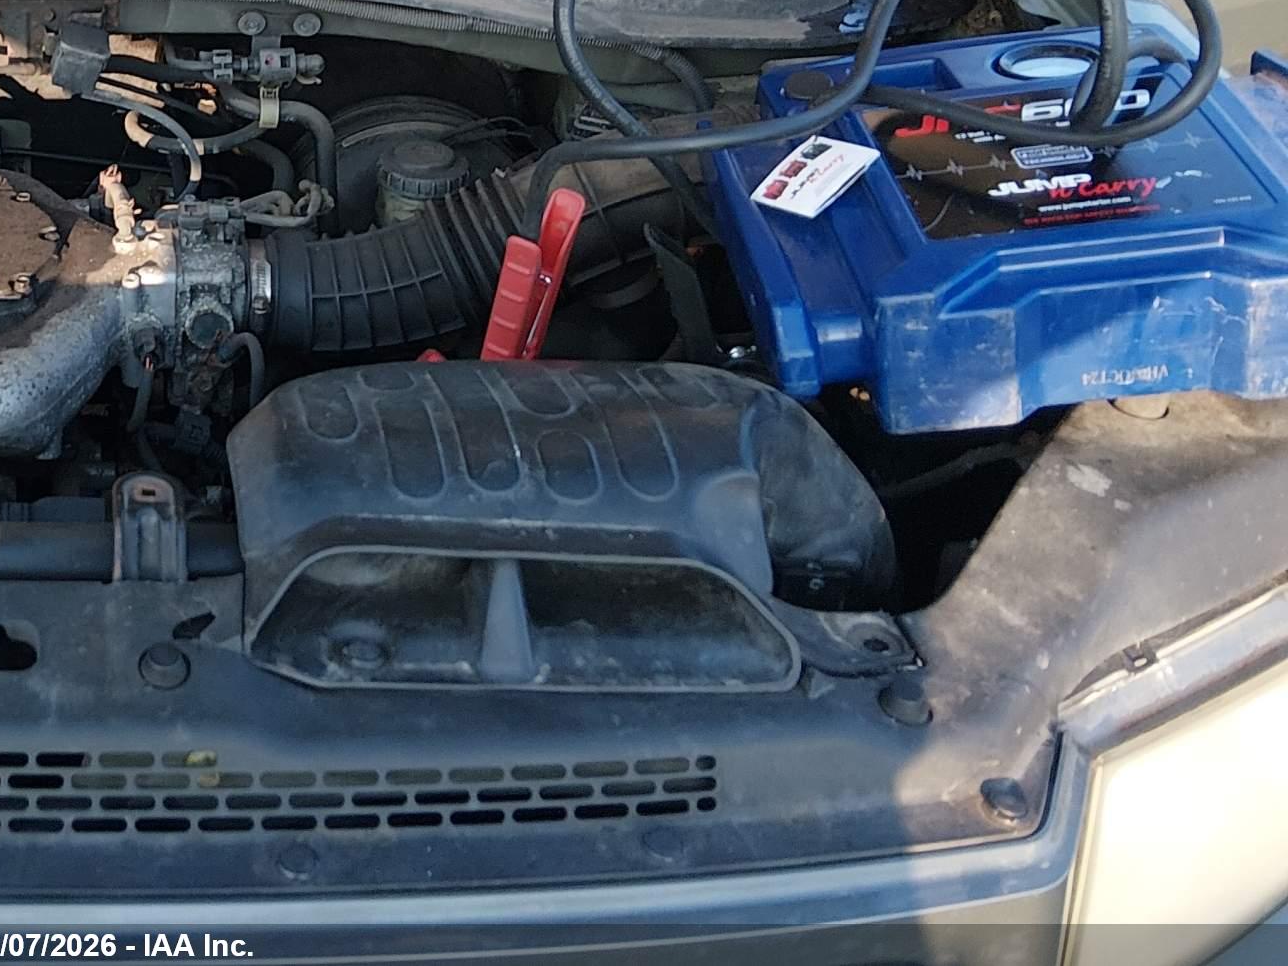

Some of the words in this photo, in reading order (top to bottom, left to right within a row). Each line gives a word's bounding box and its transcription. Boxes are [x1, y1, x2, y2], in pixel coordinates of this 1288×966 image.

[987, 173, 1092, 197] JUMP
[1048, 186, 1073, 198] n
[1078, 177, 1157, 201] Carry
